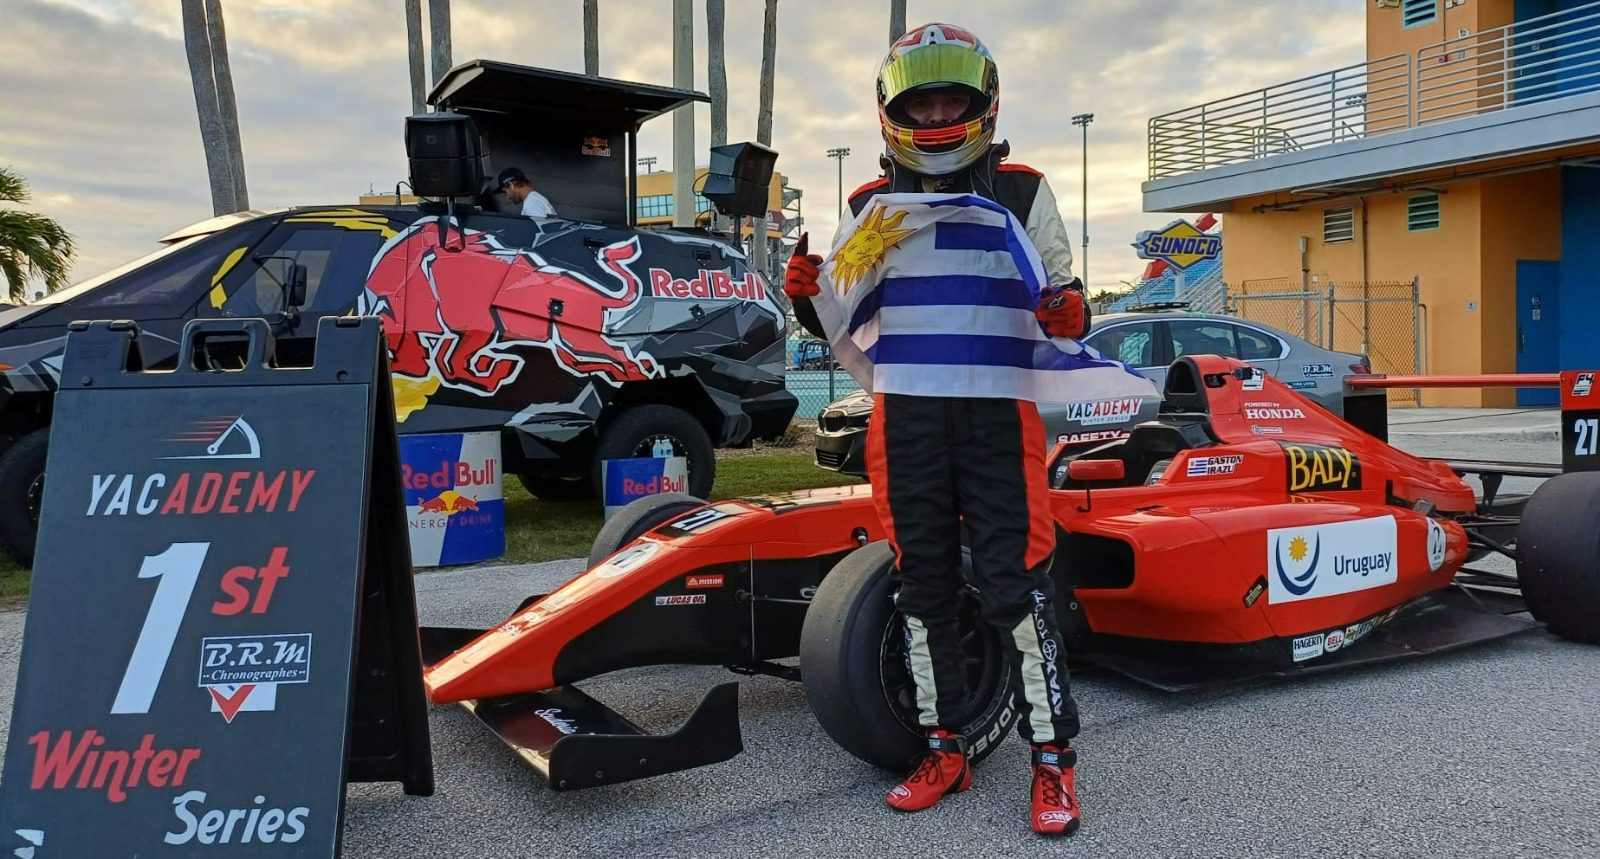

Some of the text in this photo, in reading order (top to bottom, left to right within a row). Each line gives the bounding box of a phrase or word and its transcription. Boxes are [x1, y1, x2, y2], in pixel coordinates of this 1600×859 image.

[1149, 236, 1218, 255] SUNOCO
[650, 268, 765, 301] Red Bull
[1576, 374, 1594, 385] F4
[1067, 399, 1140, 418] YACADEMY
[1245, 408, 1306, 420] HONDA
[1058, 430, 1121, 443] SAFETY
[1574, 418, 1599, 456] 27
[1207, 455, 1243, 466] GASTON
[1286, 446, 1352, 492] BALY
[401, 459, 496, 490] Red Bull
[86, 470, 316, 517] YACADEMY
[623, 474, 685, 495] Red Bull
[409, 518, 456, 529] NERGY
[1334, 551, 1392, 577] Uruguay
[666, 595, 704, 604] LUCAS OIL
[1294, 634, 1323, 650] HAGERTY
[1327, 634, 1343, 646] BELL
[204, 642, 308, 667] B.R.M
[211, 665, 298, 682] Chronographes
[967, 690, 1016, 761] OPER
[27, 730, 203, 803] Winter
[1041, 754, 1059, 763] OMP
[165, 790, 311, 845] Series
[1040, 812, 1072, 823] OMP
